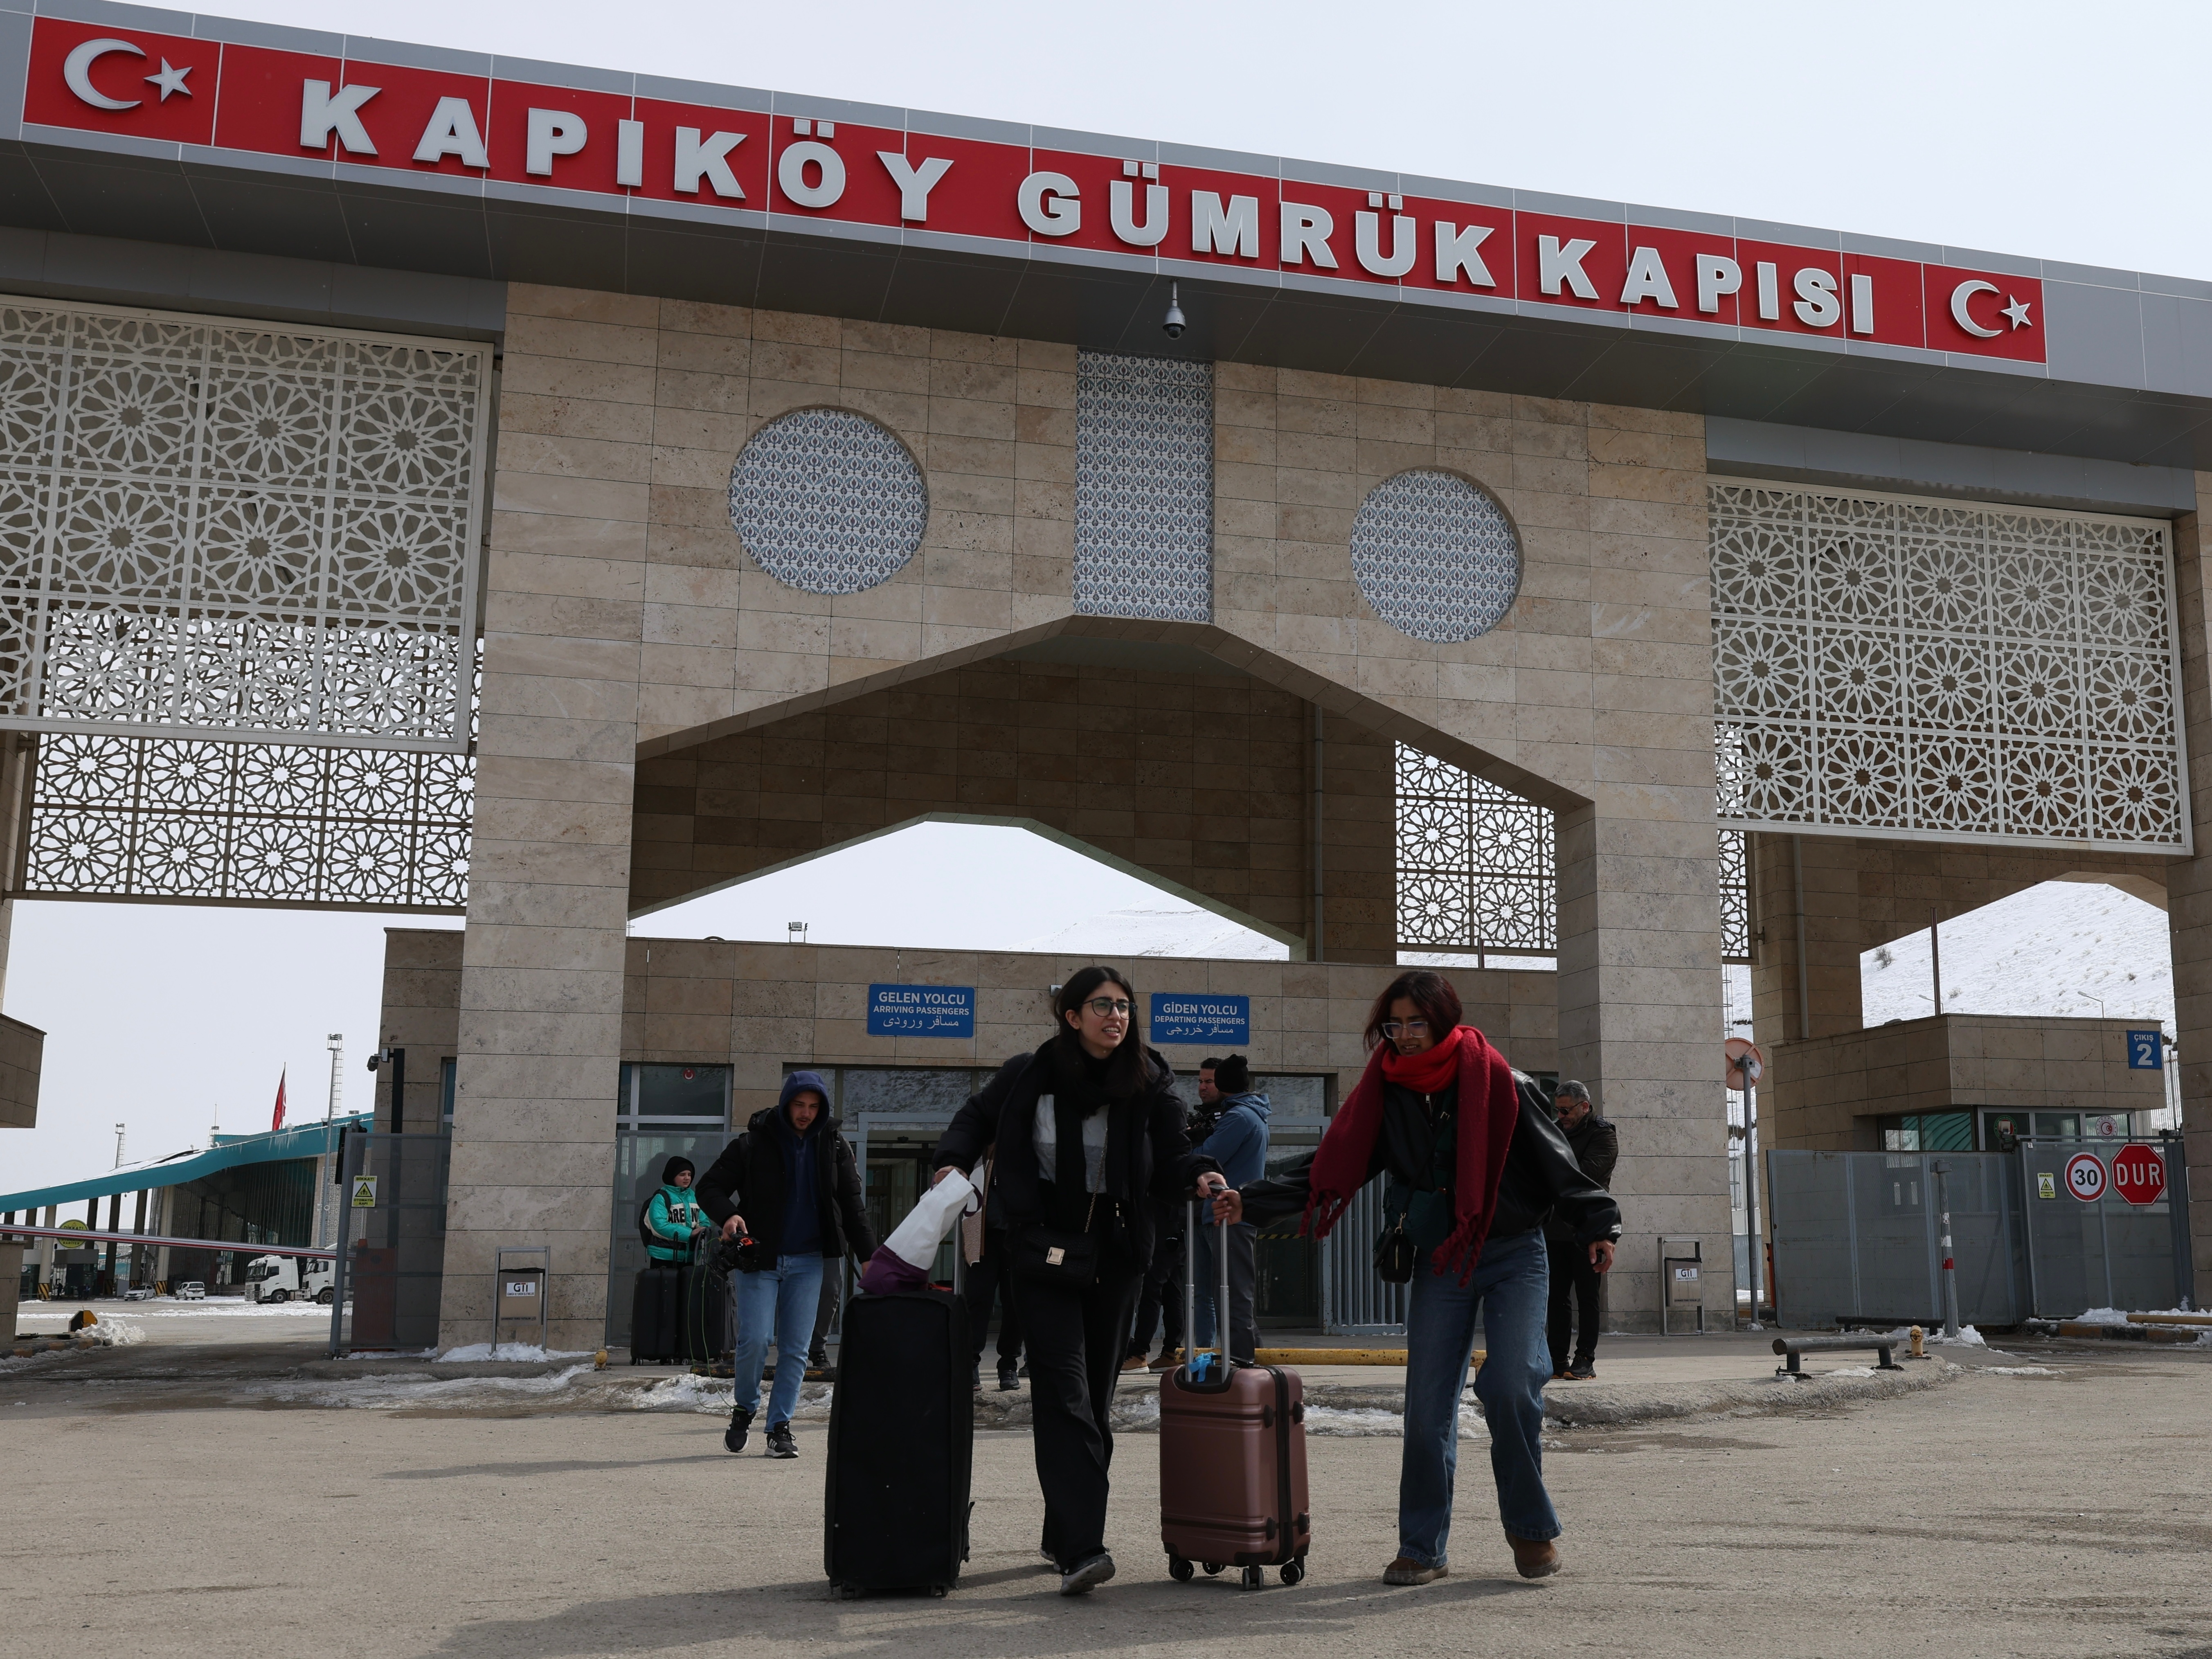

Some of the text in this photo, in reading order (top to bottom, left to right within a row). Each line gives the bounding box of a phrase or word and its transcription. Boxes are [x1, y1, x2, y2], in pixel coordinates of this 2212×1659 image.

[300, 79, 1874, 334] KAPIKÖY GÜMRÜK KAPISI
[879, 992, 965, 1005] GELEN YOLCU
[916, 1007, 969, 1015] PASSENGERS
[1163, 1002, 1237, 1015] GİDEN YOLCU
[927, 1015, 959, 1029] مسافر
[1207, 1024, 1233, 1036] مسافر
[2137, 1043, 2153, 1065] 2
[2075, 1169, 2098, 1186] 30
[2116, 1163, 2161, 1186] DUR
